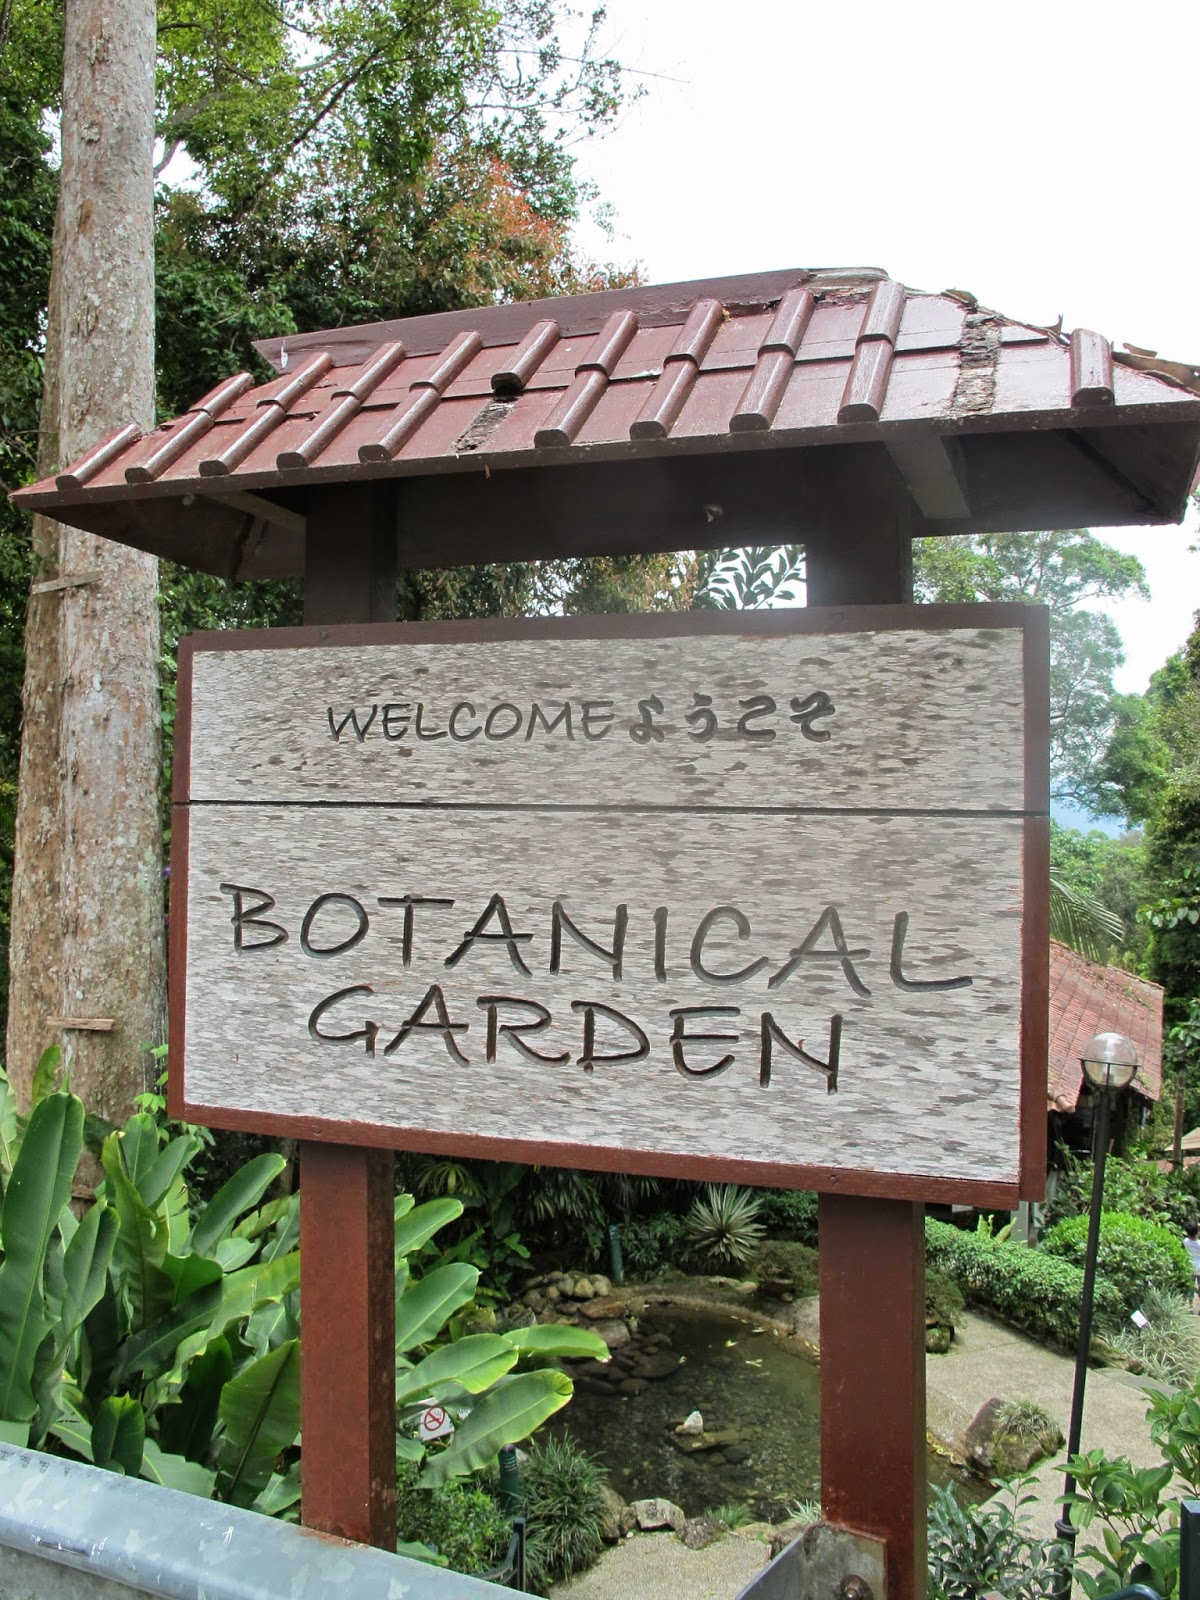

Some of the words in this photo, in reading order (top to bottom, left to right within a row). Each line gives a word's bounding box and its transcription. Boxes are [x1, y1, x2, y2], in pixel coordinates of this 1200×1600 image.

[327, 701, 615, 743] WELCOME
[220, 883, 973, 997] BOTANICAL
[308, 985, 842, 1094] GARDEN
